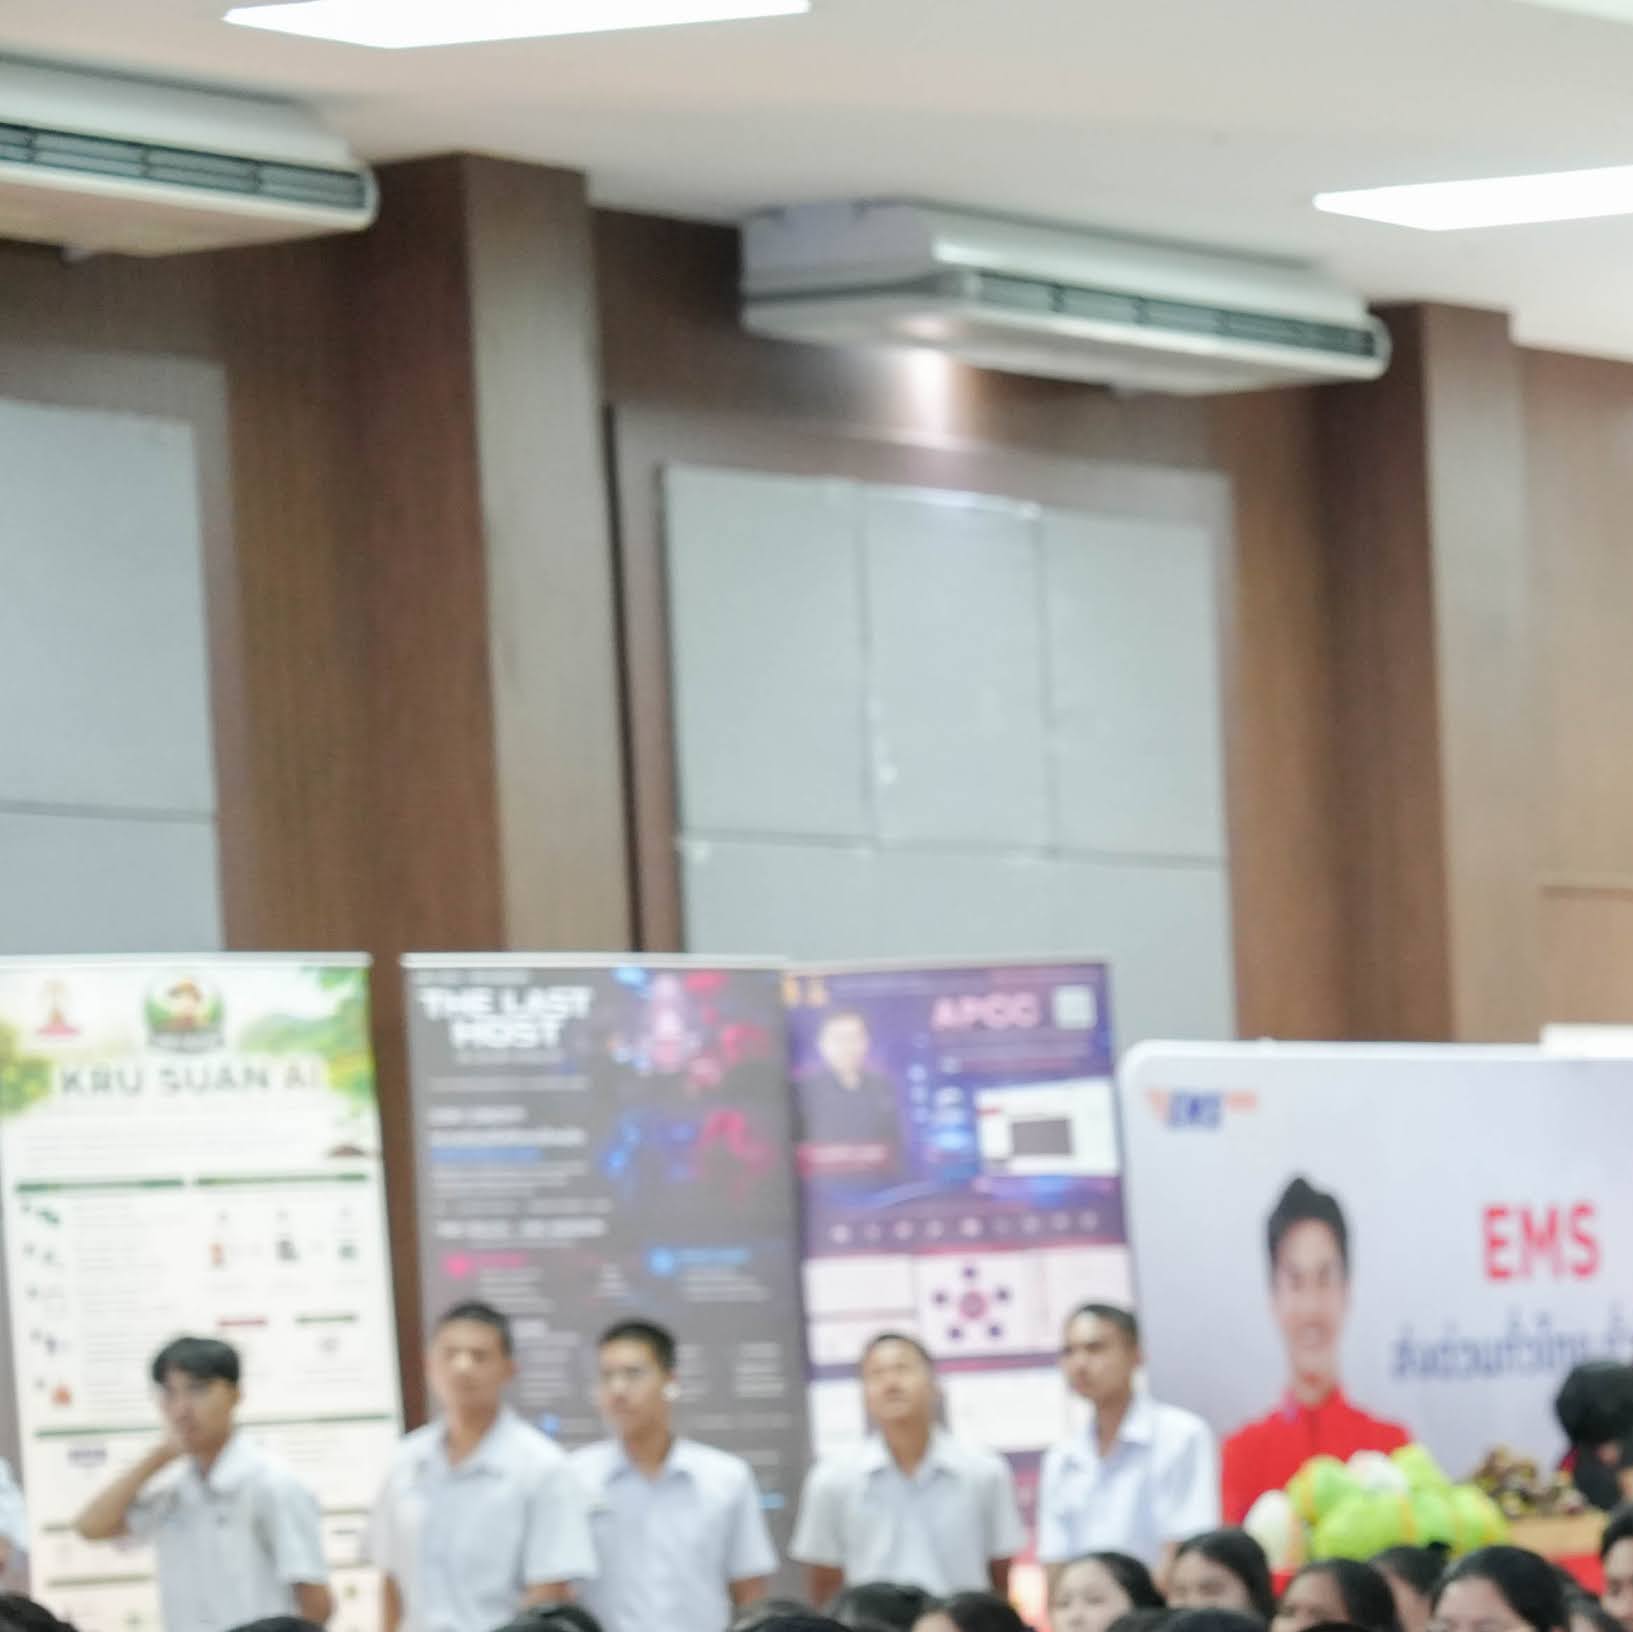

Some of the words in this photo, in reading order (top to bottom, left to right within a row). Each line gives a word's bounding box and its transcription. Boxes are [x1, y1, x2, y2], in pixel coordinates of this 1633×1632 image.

[61, 1062, 143, 1096] KRU
[159, 1062, 270, 1092] SUAN
[1482, 1203, 1602, 1282] EMS
